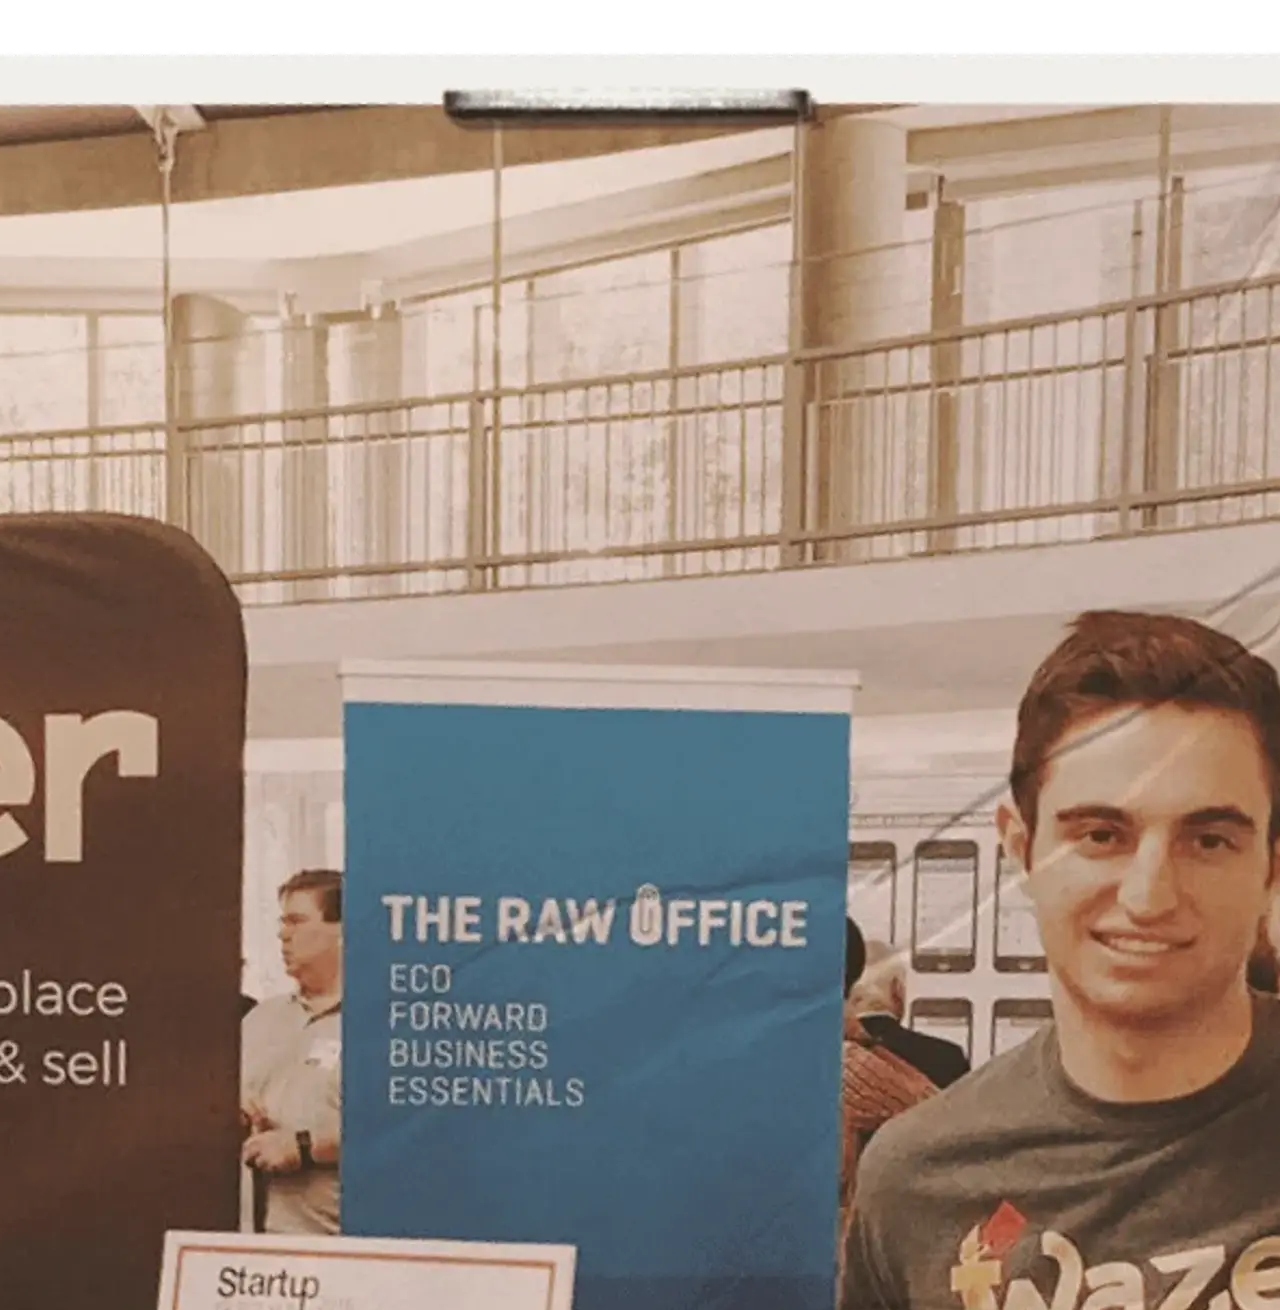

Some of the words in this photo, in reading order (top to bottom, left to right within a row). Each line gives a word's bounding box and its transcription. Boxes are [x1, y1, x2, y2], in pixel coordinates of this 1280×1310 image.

[382, 894, 482, 944] THE
[498, 896, 616, 945] RAW
[630, 883, 809, 948] OFFICE
[390, 963, 452, 994] ECO
[390, 1001, 548, 1032] FORWARD
[42, 1039, 128, 1087] sell
[389, 1038, 548, 1070] BUSINESS
[389, 1076, 585, 1107] ESSENTIALS
